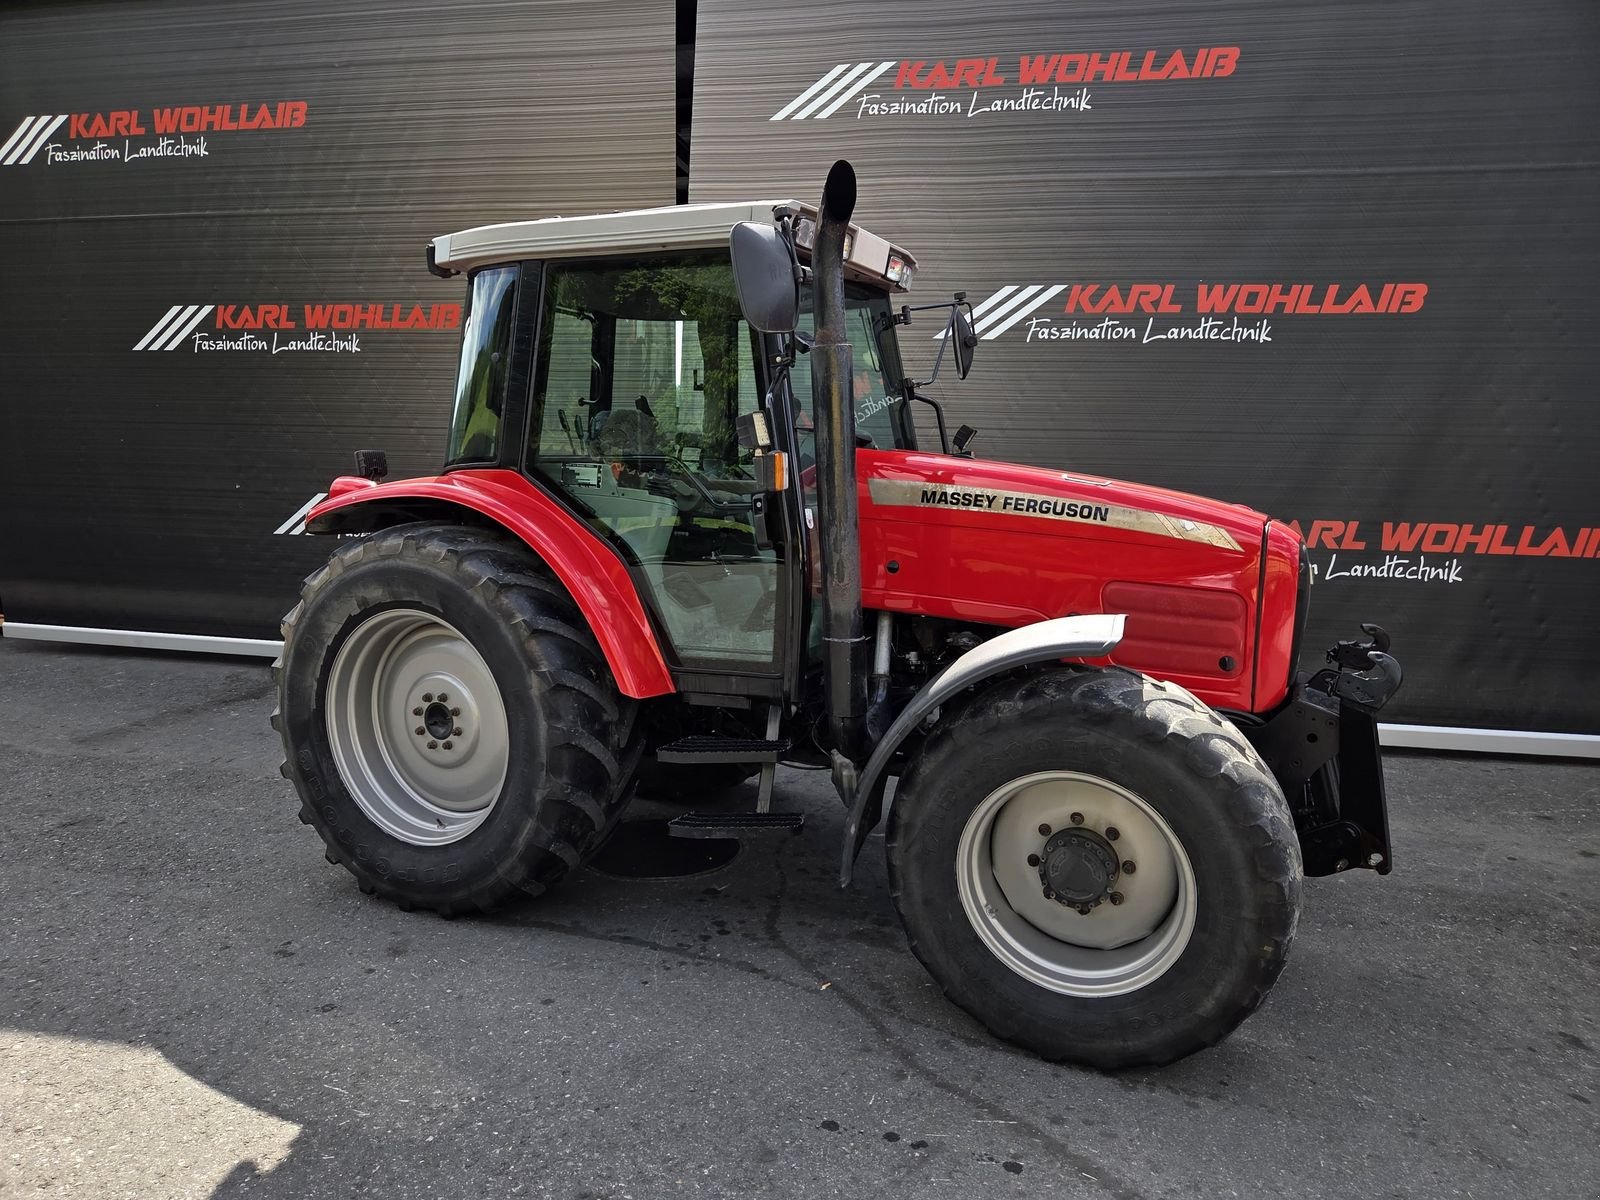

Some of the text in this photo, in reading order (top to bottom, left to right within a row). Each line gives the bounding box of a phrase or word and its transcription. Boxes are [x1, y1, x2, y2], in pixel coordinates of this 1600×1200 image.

[894, 57, 1005, 89] KARL
[856, 86, 1092, 119] Faszination Landtechnik
[69, 111, 146, 139] KARL
[45, 136, 209, 165] Faszination Landtechnik
[1064, 284, 1182, 313] KARL
[215, 304, 295, 330] KARL
[1025, 317, 1272, 344] Faszination Landtechnik
[191, 332, 361, 354] Faszination Landtechnik
[920, 489, 1110, 522] MASSEY FERGUSON
[1325, 554, 1463, 583] Landtechnik
